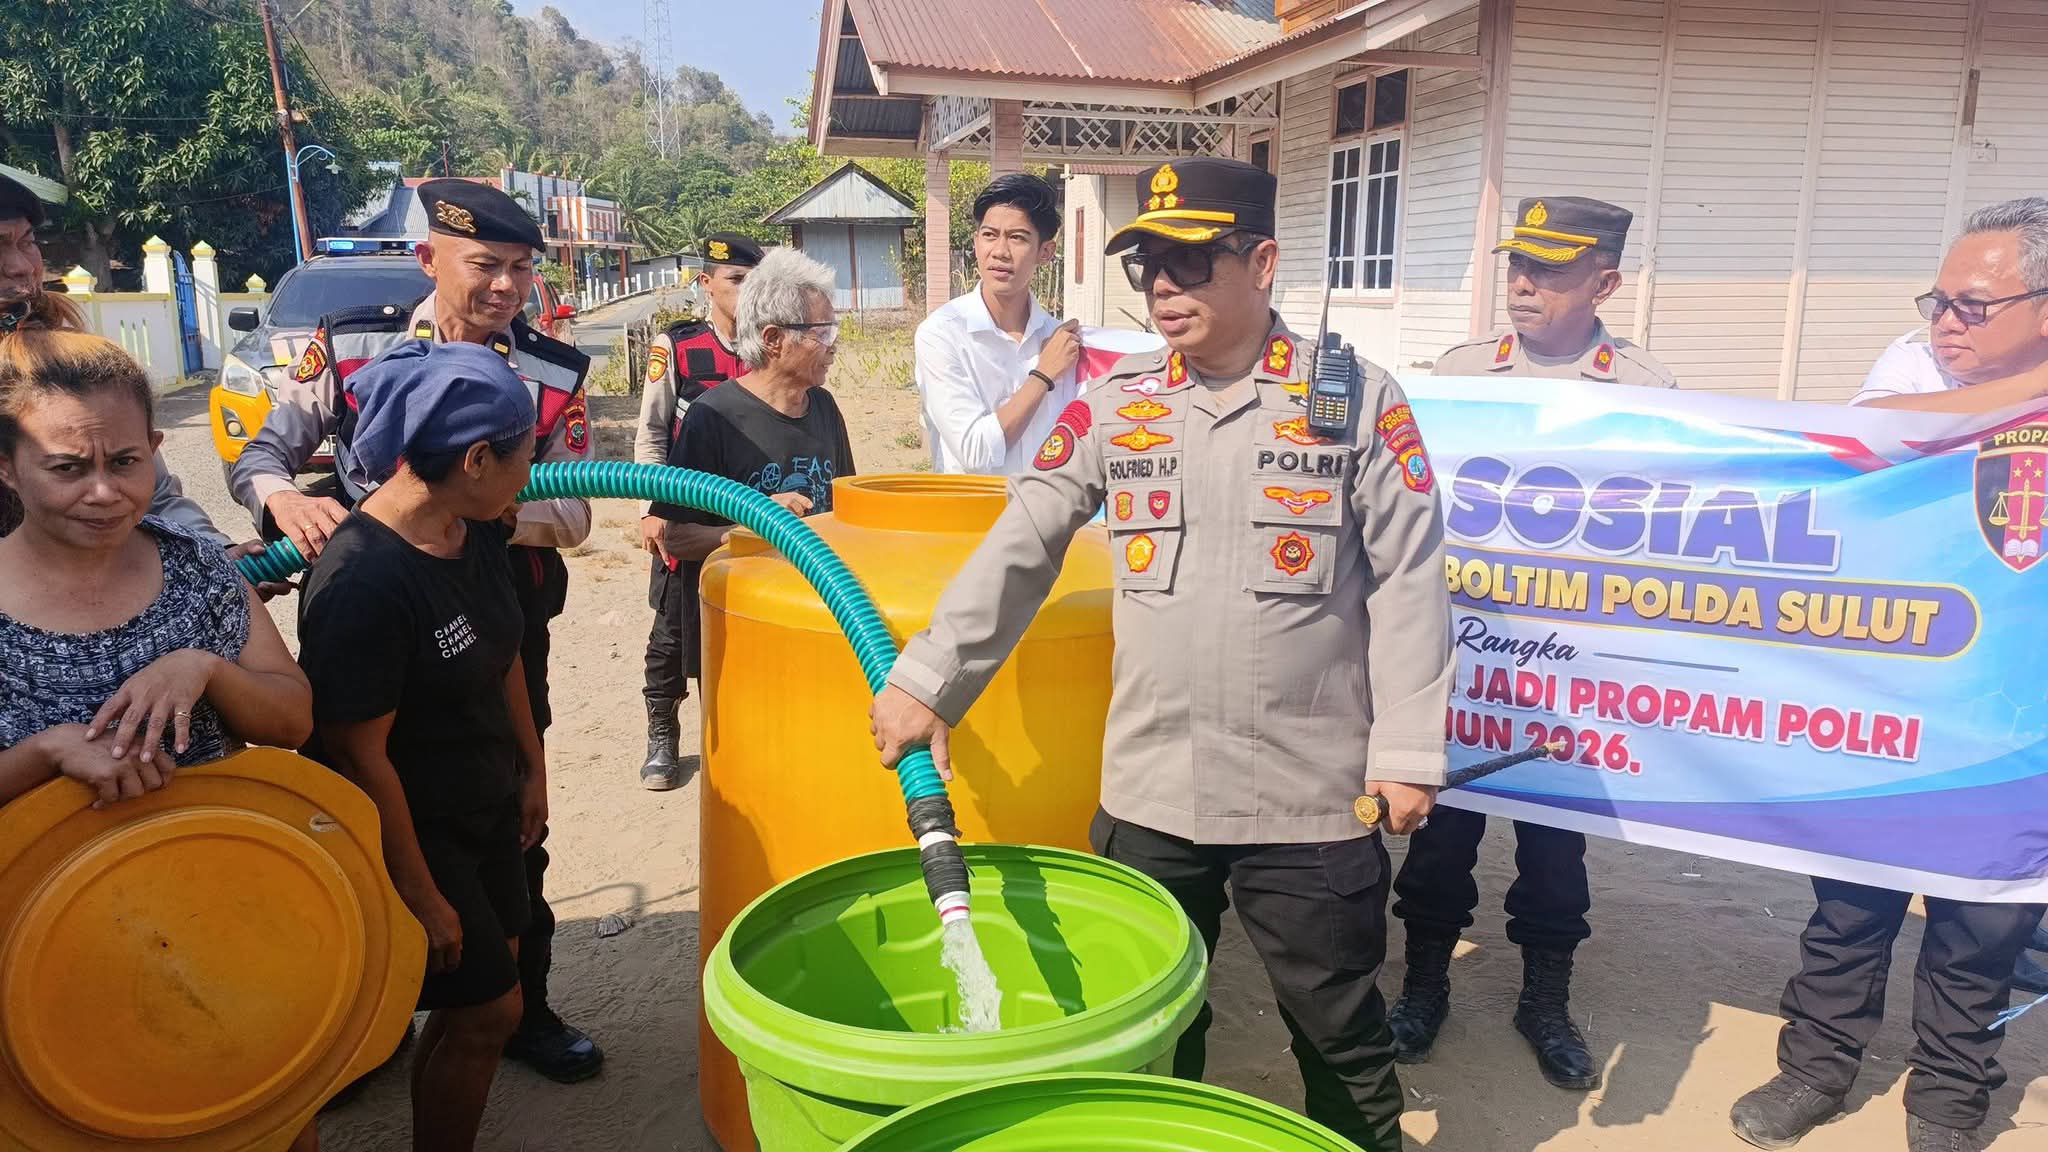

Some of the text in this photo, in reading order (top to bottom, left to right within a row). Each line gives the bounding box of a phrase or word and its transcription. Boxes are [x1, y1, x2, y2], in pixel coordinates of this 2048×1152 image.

[1109, 457, 1154, 480] GOLFRIED
[1257, 450, 1343, 476] POLRI
[1445, 455, 1840, 570] SOSIAL
[1446, 555, 1939, 644] BOLTIM POLDA SULUT
[434, 613, 467, 639] CHANEL
[438, 622, 472, 649] CHANEL
[442, 632, 477, 659] CHANEL
[1456, 616, 1579, 667] Rangka
[1466, 664, 1920, 759] JADI PROPAM POLRI
[1525, 721, 1640, 773] 2026.
